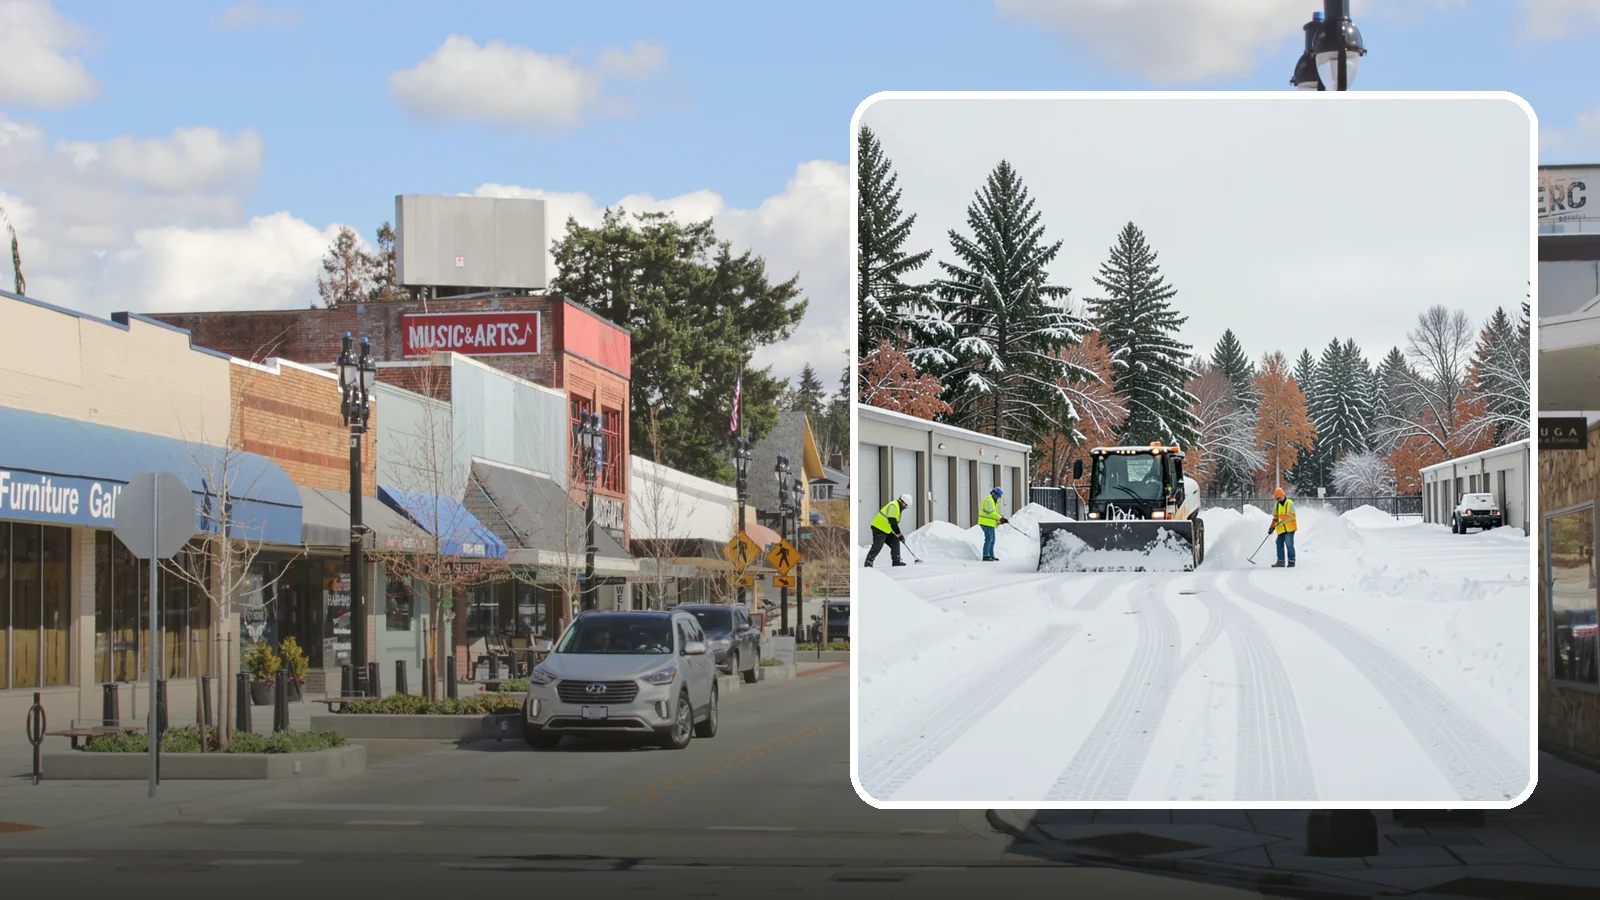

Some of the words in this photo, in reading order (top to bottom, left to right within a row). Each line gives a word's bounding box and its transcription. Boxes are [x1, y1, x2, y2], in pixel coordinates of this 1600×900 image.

[1540, 427, 1577, 437] UGA
[0, 471, 79, 515] Furniture
[90, 482, 122, 519] Gal
[453, 563, 479, 574] SUSHI
